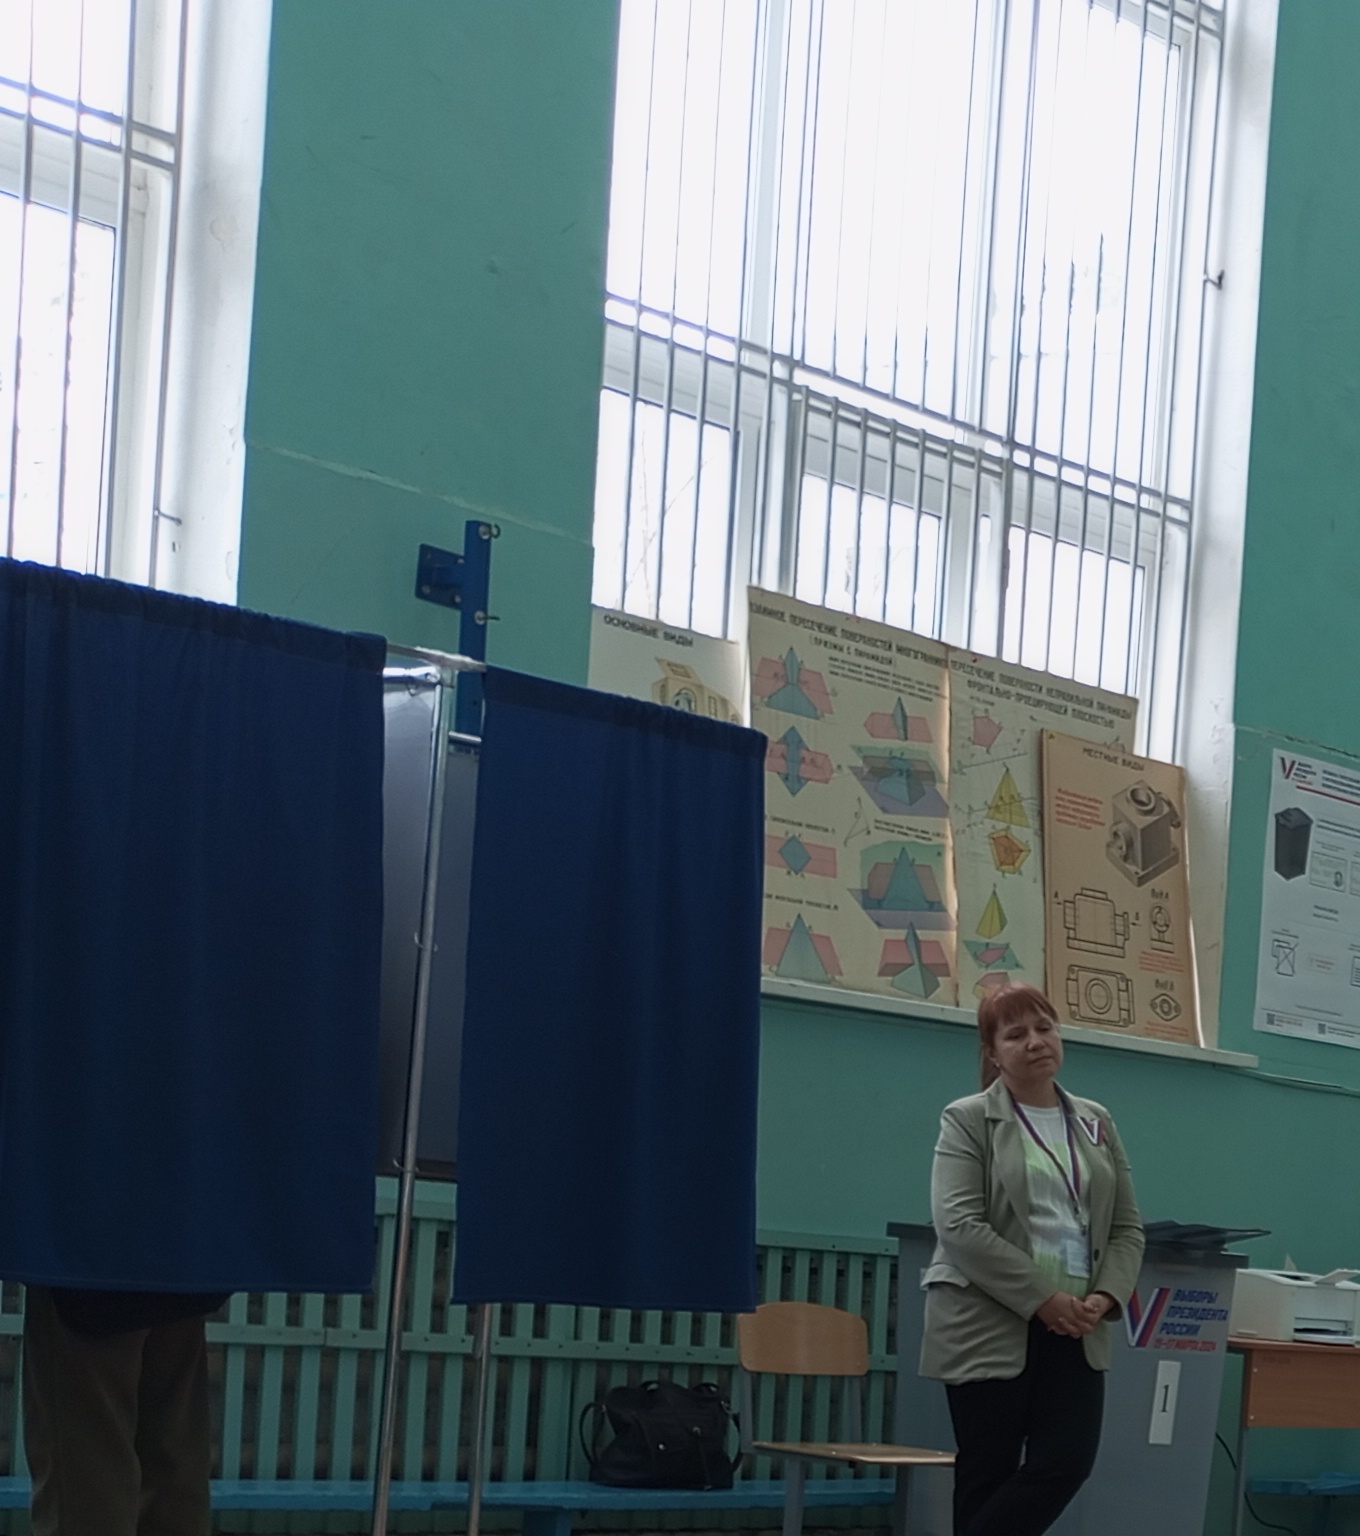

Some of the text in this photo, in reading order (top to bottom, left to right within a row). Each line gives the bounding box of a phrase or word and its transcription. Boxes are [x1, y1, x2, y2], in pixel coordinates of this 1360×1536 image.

[603, 614, 694, 646] ОСНОВНЫЕ ВИДЫ
[1083, 747, 1145, 771] МЕСТНЫЕ ВИДЫ
[1173, 1288, 1219, 1304] ВЫБОРЫ
[1166, 1305, 1229, 1321] ПРЕЗИДЕНТА
[1159, 1322, 1201, 1337] РОССИИ
[1160, 1384, 1170, 1413] 1
